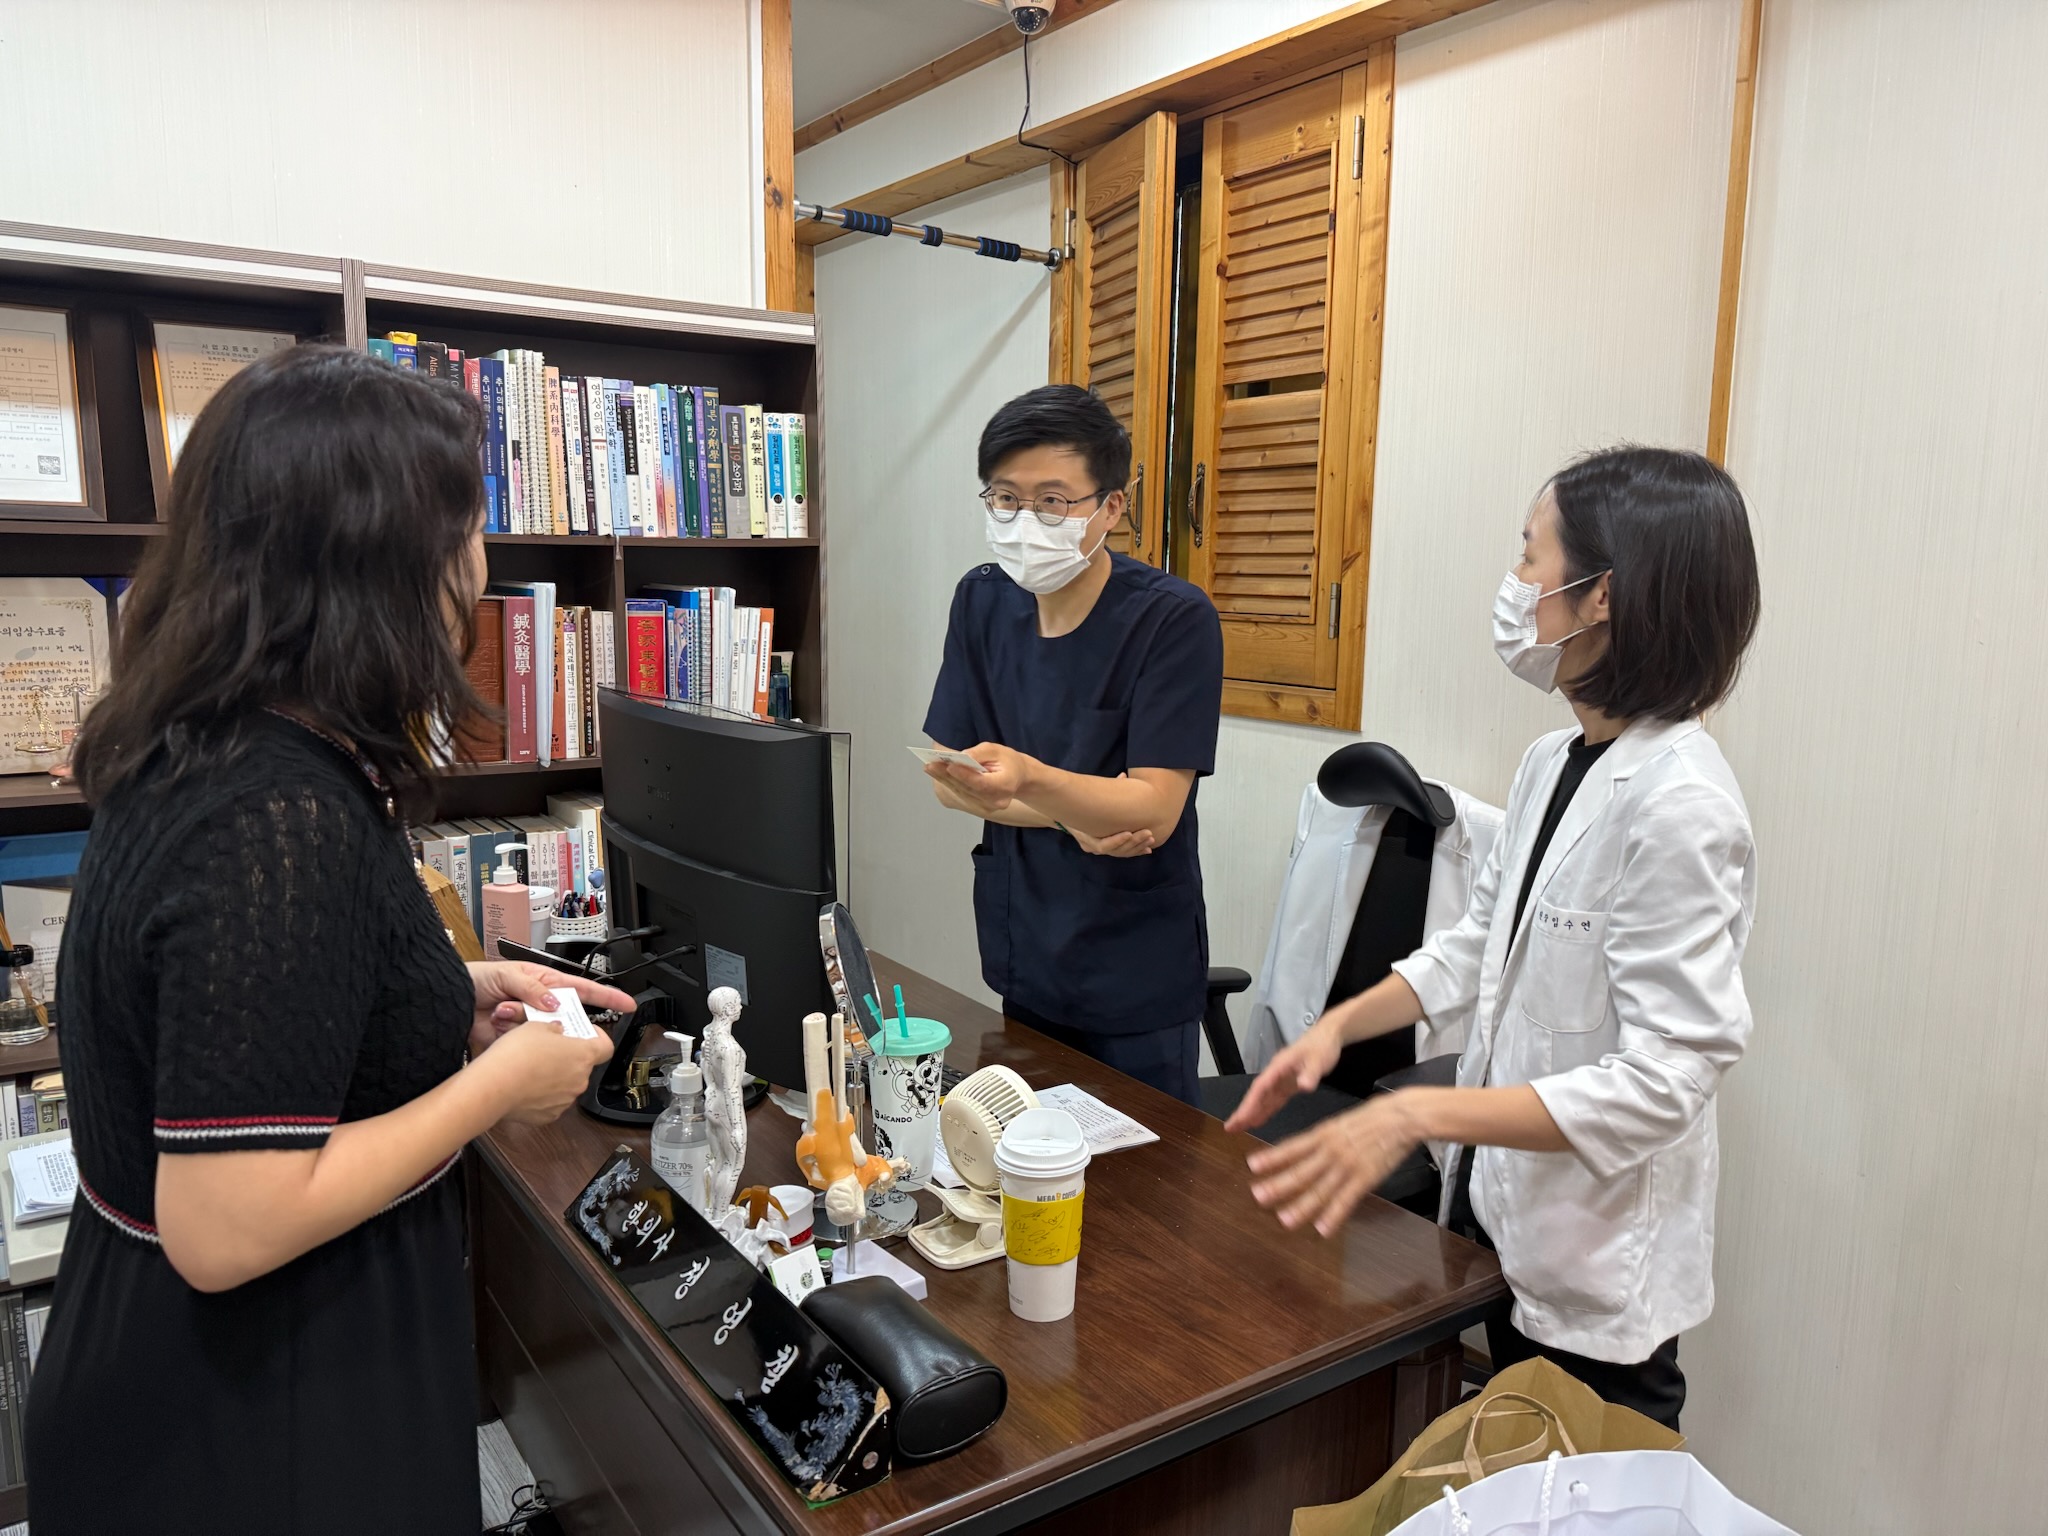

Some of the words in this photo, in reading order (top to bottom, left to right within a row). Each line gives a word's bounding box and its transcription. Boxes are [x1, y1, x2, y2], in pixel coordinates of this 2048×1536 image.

[591, 383, 604, 437] 영상의학
[706, 397, 718, 421] 바른
[0, 627, 66, 637] 의임상수료증
[512, 613, 531, 676] 鍼灸醫學
[587, 830, 595, 854] Clinical
[1551, 916, 1591, 932] 임수연
[678, 1162, 694, 1170] 70%
[621, 1199, 676, 1263] 한의사
[674, 1255, 711, 1301] 정
[713, 1296, 753, 1346] 영
[760, 1343, 799, 1395] 철
